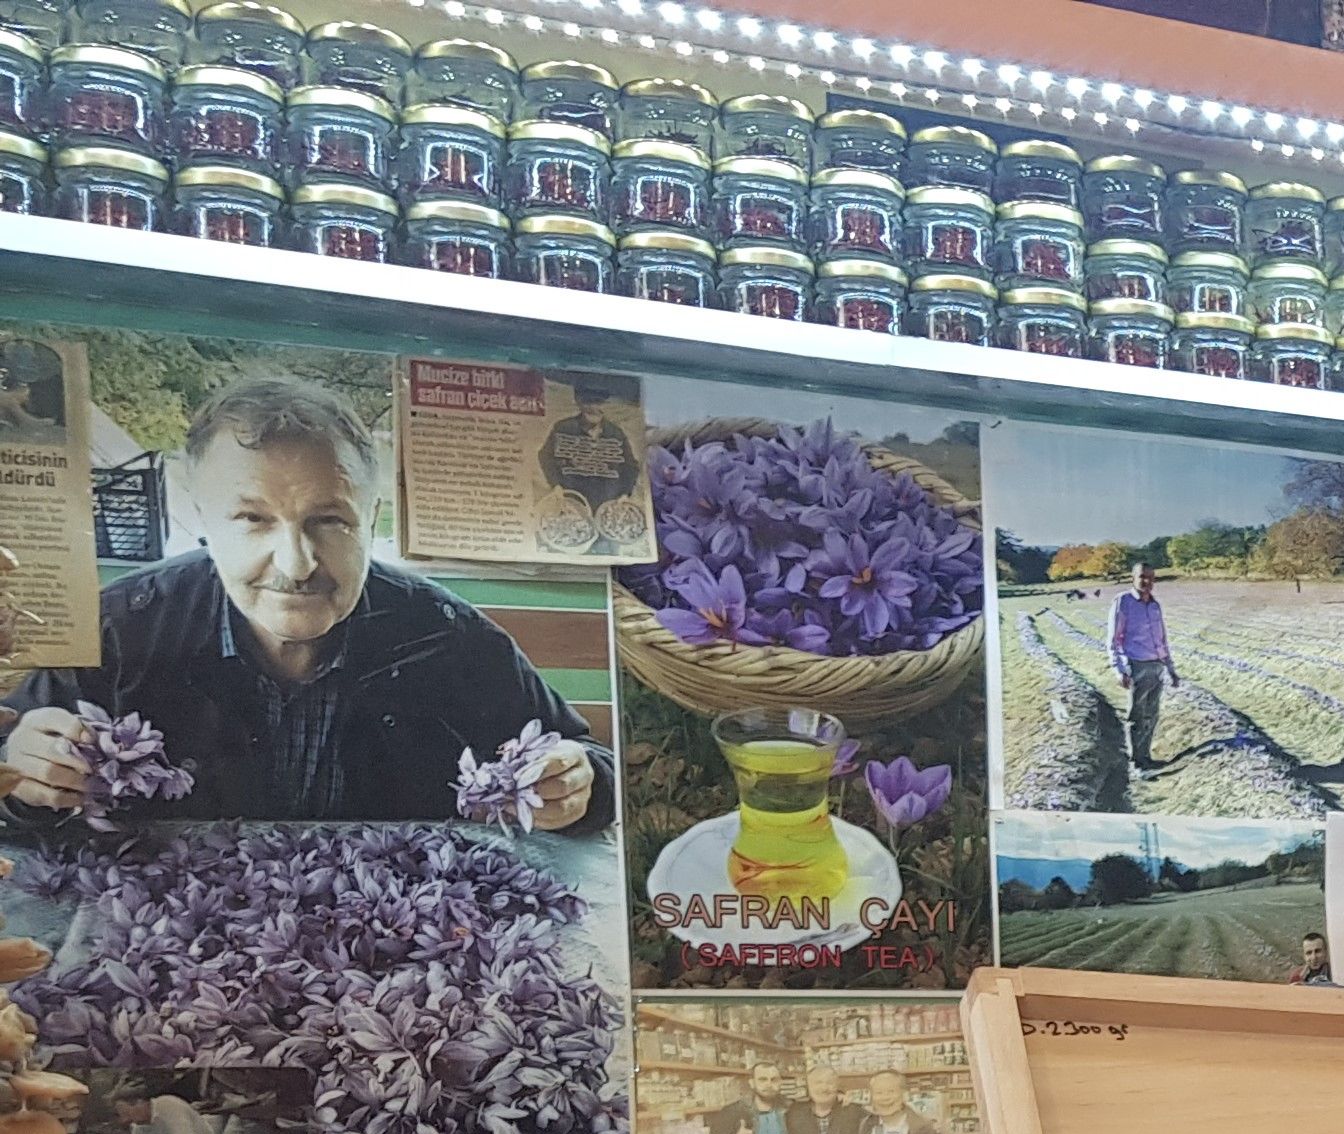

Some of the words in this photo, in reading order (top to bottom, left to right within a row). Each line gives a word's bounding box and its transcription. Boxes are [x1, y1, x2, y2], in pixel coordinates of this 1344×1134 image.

[417, 364, 469, 386] Mucize
[471, 366, 504, 389] bitki
[417, 386, 464, 407] safran
[0, 450, 68, 469] ticisinin
[0, 470, 56, 488] ldürdü
[653, 893, 831, 930] SAFRAN
[859, 896, 957, 940] ÇAYI
[1108, 1023, 1129, 1041] gr
